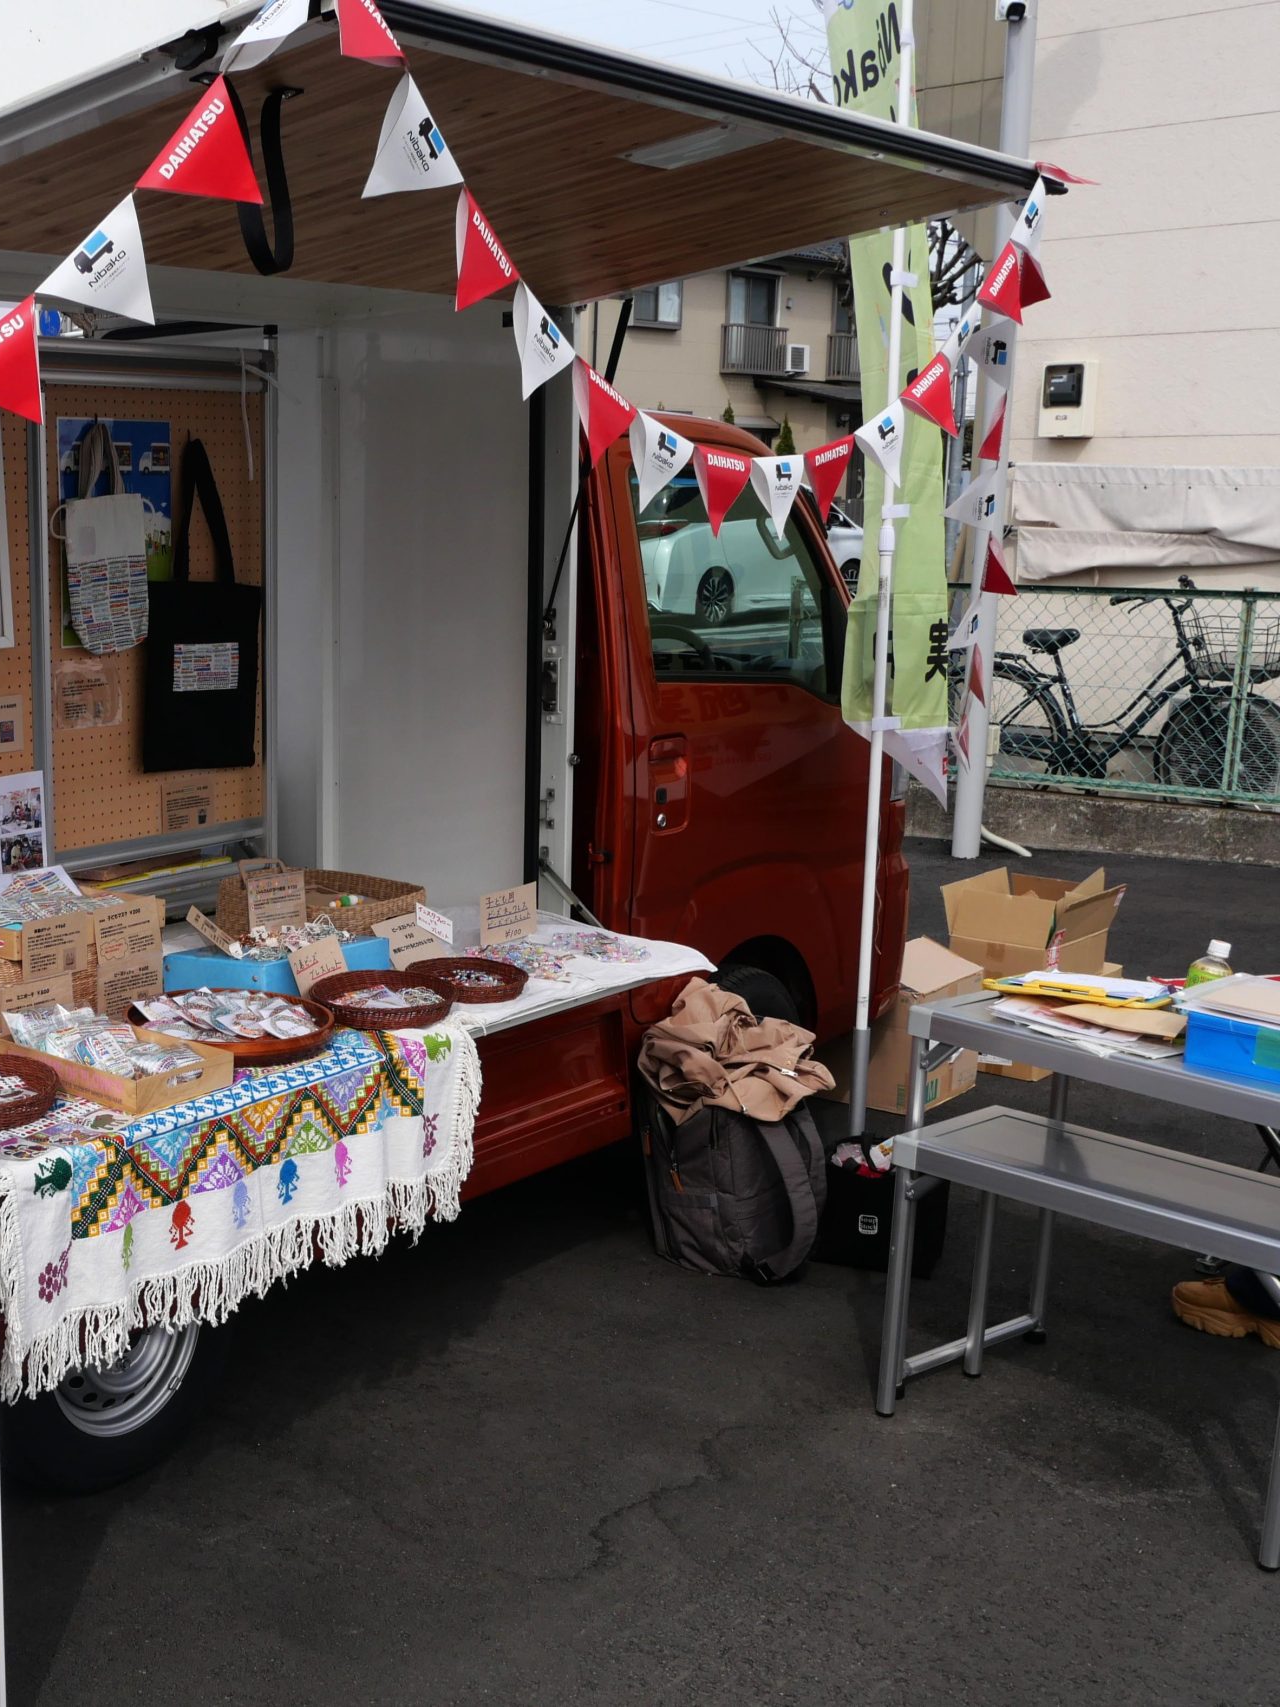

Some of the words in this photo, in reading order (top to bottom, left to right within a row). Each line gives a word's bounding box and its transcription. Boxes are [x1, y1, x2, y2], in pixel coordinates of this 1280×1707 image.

[256, 0, 286, 31] Nibak
[361, 0, 401, 52] HATSU
[159, 97, 226, 180] DAIHATSU
[405, 129, 431, 173] Nibako
[473, 210, 513, 278] DAIHATSU
[88, 248, 127, 289] Nibako
[989, 254, 1016, 297] DAIHATSU
[533, 332, 556, 362] Nibako
[589, 368, 630, 412] DAIHATSU
[911, 362, 945, 399] DAIHATSU
[707, 453, 745, 472] DAIHATSU
[815, 444, 849, 467] DAIHATSU
